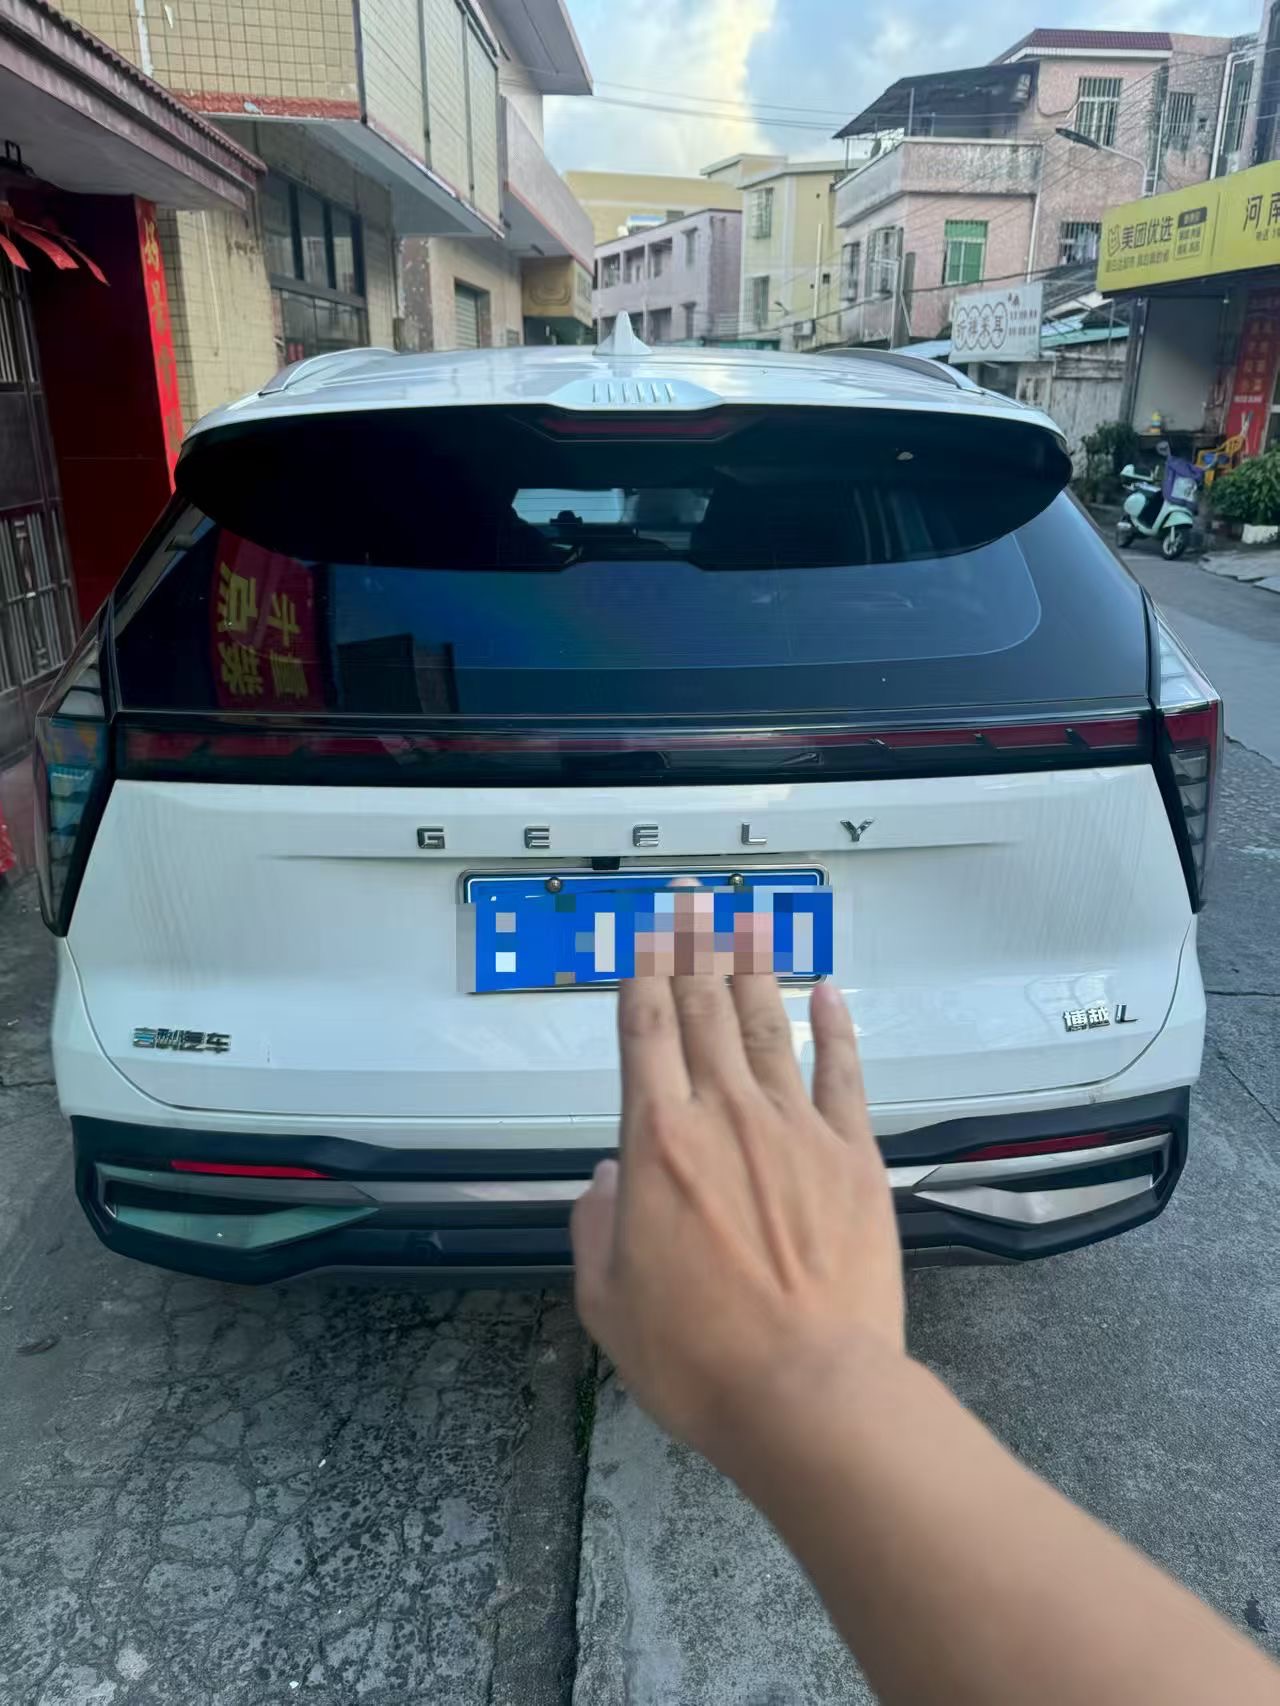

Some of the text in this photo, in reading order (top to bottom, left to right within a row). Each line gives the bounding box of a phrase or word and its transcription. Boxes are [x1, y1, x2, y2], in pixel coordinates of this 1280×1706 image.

[1121, 215, 1174, 251] 美团优选
[417, 819, 875, 849] GEELY
[134, 1027, 231, 1053] 吉利汽车
